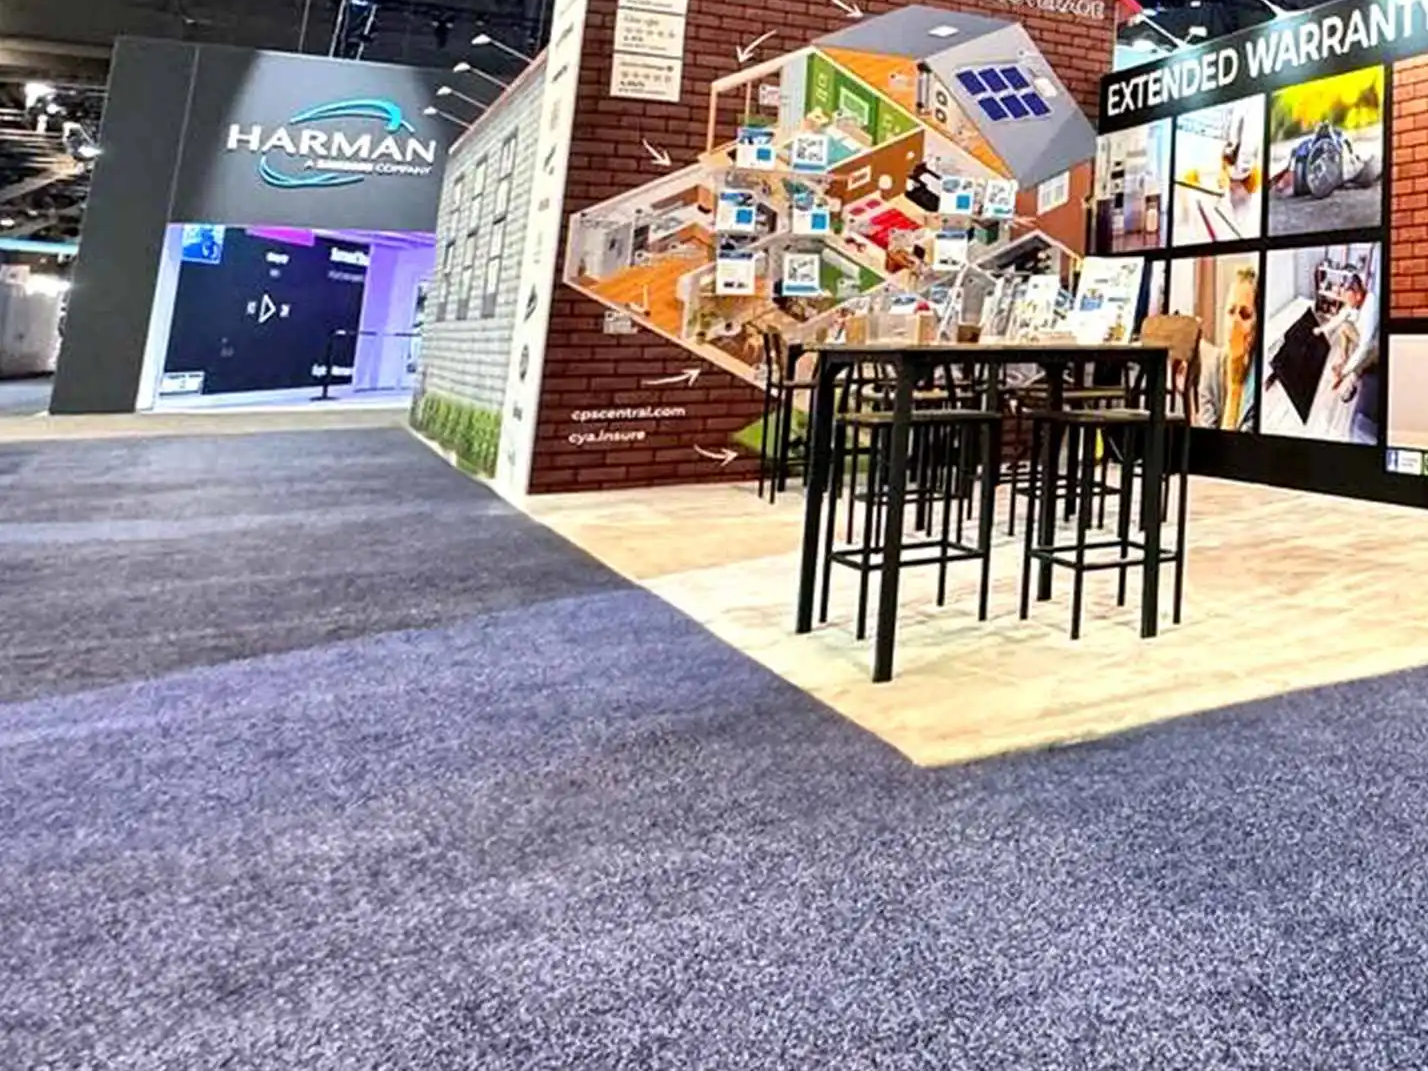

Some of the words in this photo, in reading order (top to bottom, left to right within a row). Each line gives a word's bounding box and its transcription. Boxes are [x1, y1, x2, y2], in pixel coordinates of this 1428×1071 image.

[1106, 48, 1239, 117] EXTENDED
[225, 122, 437, 164] HARMAN
[571, 405, 686, 423] cpscentral.com
[568, 428, 647, 446] cya.insure
